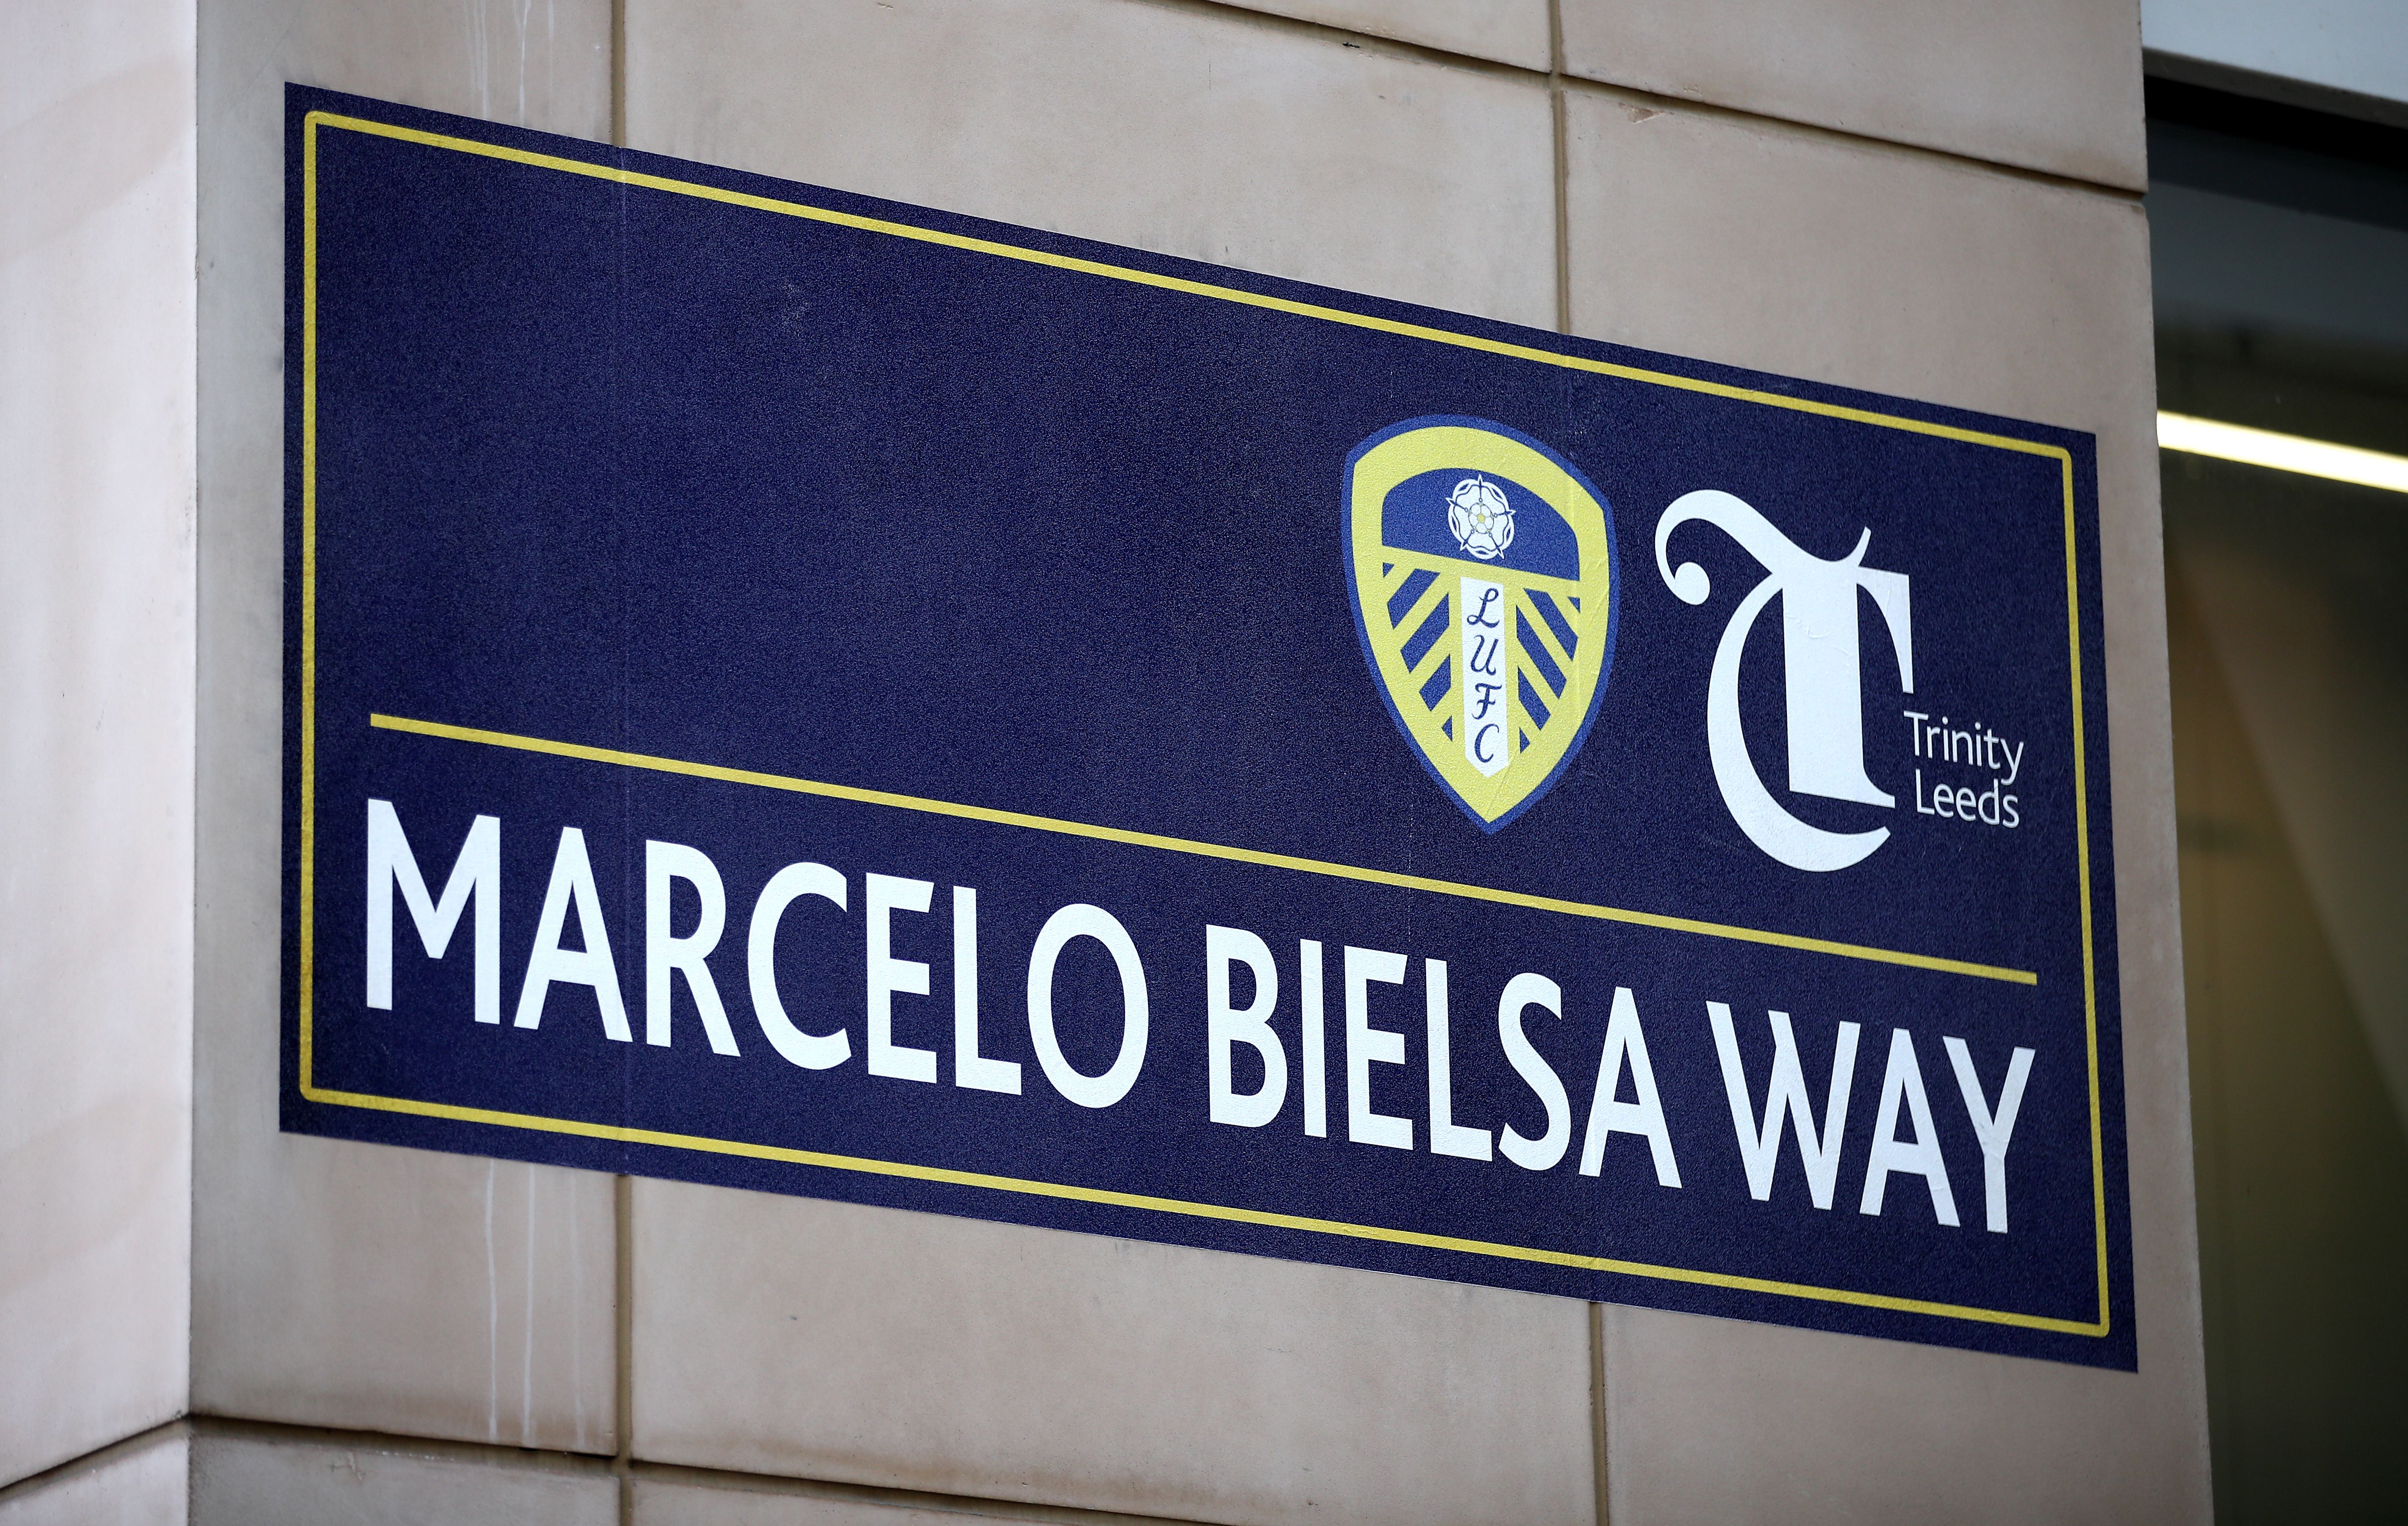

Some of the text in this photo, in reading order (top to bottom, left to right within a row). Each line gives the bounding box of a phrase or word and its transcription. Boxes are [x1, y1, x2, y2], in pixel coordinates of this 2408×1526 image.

[1467, 588, 1502, 763] LUFC
[1904, 710, 2024, 785] Trinity
[1915, 768, 2020, 828] Leeds
[367, 798, 2035, 1234] MARCELO BIELSA WAY
